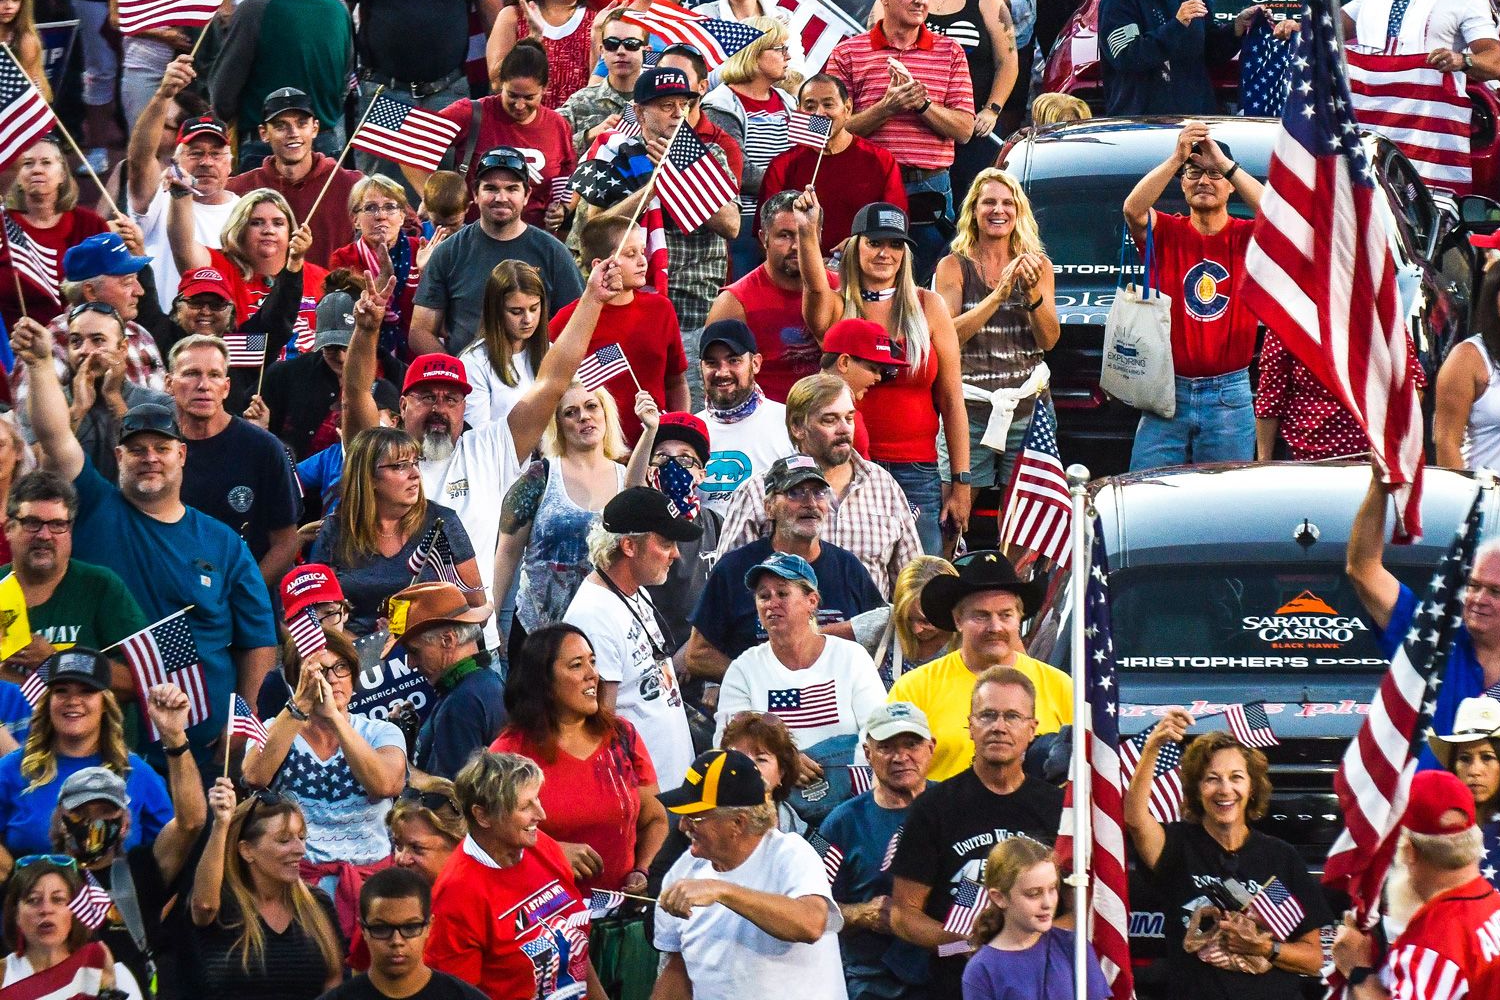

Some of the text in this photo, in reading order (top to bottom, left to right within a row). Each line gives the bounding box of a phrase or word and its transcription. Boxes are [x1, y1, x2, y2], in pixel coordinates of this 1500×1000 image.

[655, 73, 685, 86] I'M A
[286, 572, 328, 594] AMERICA
[1243, 616, 1369, 632] SARATOGA
[41, 625, 82, 643] WAY
[1258, 627, 1353, 642] CASINO
[1271, 642, 1341, 650] BLACK HAWK
[1116, 656, 1391, 668] HRISTOPHER'S DOD
[348, 675, 428, 711] EP AMERICA GREAT
[1294, 699, 1372, 718] plu
[952, 833, 993, 857] UNITED
[529, 891, 553, 911] STAND
